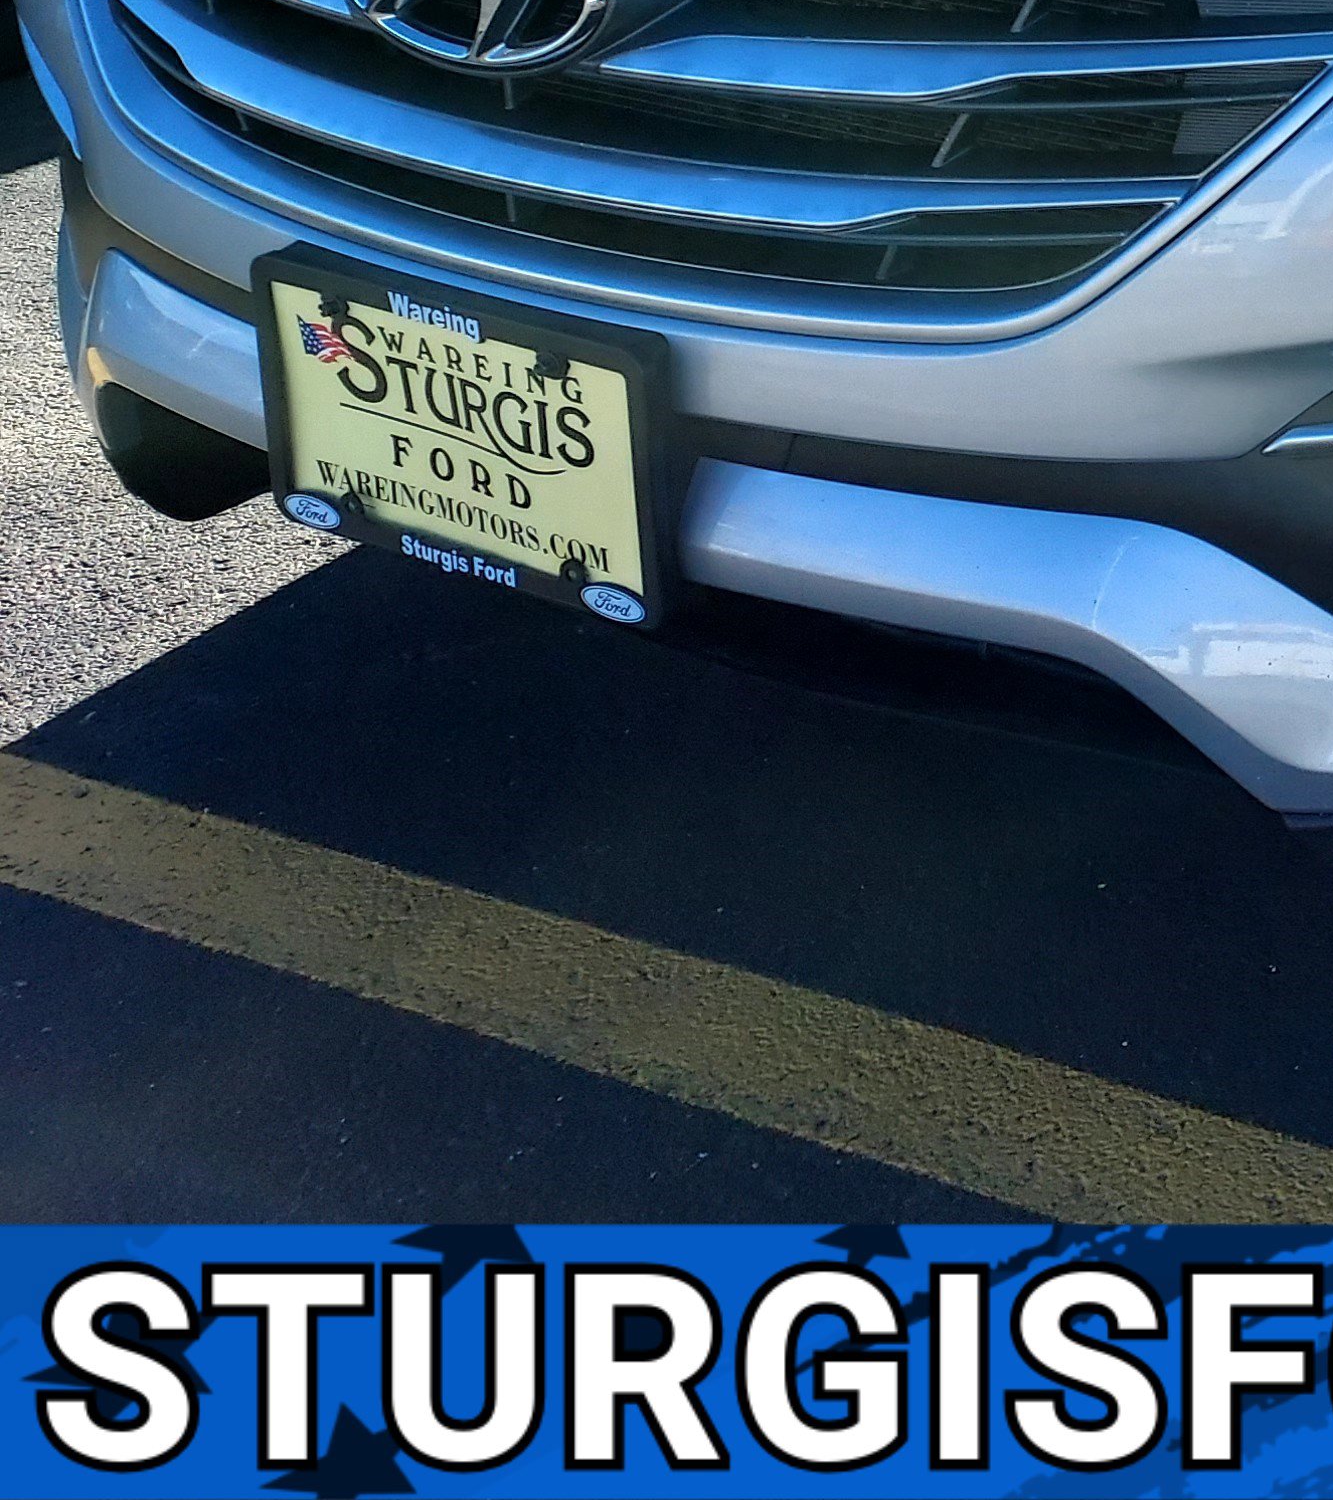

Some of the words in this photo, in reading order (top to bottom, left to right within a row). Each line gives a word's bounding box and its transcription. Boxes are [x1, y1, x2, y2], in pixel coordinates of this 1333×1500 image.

[387, 291, 481, 342] Wareing
[337, 311, 595, 474] STURGIS
[377, 326, 584, 404] WAREING
[390, 433, 532, 510] FORD
[295, 499, 330, 525] Ford
[316, 460, 611, 574] WAREINGMOTORS.COM
[401, 534, 470, 575] Sturgis
[473, 555, 517, 588] Ford
[593, 590, 632, 619] Ford
